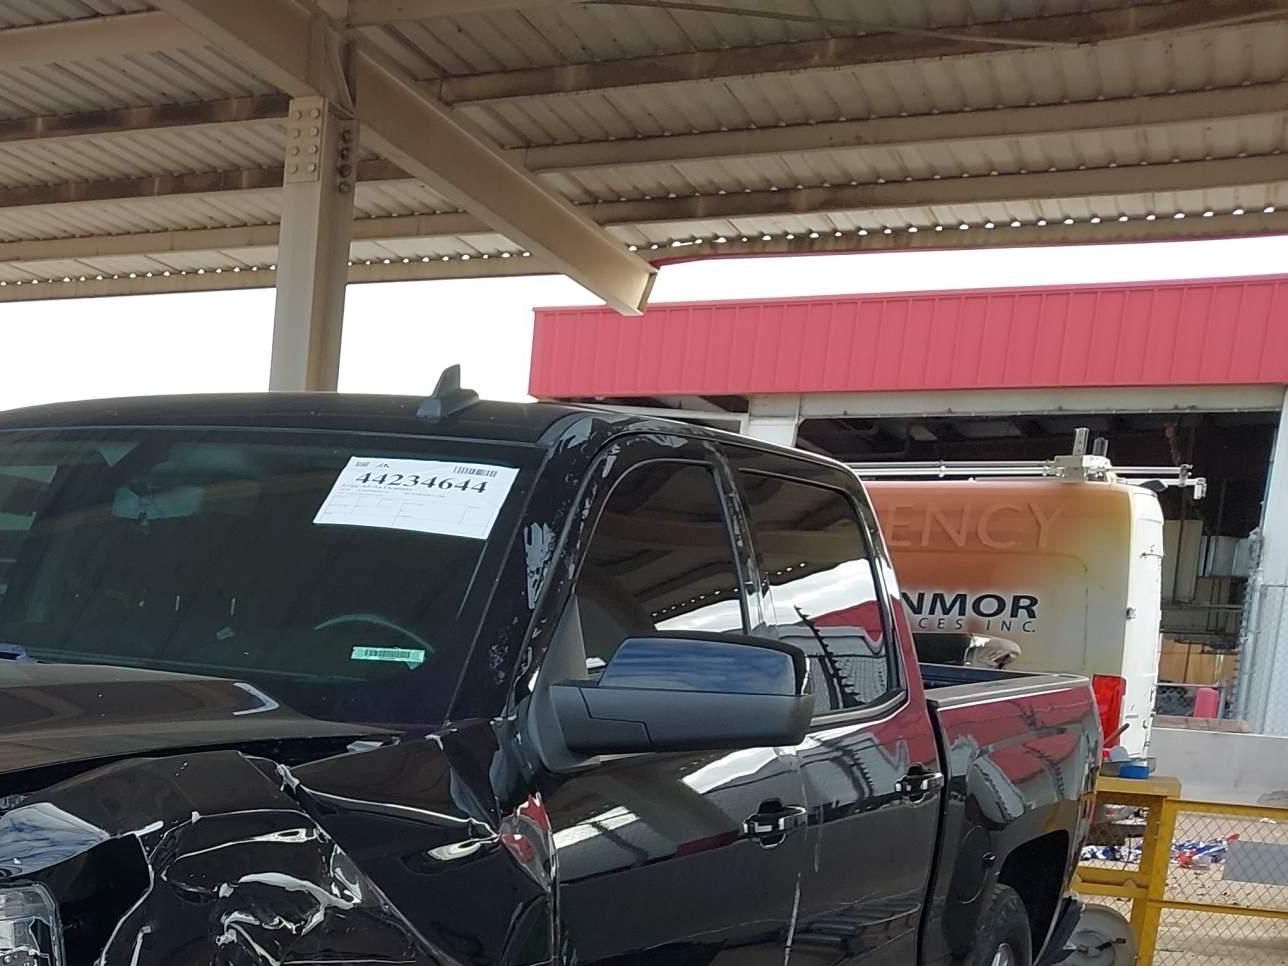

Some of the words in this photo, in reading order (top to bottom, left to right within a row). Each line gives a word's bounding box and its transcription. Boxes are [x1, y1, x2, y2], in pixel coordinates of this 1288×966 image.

[355, 472, 489, 494] 44234644
[886, 503, 1066, 549] ENCY
[986, 618, 1035, 633] INC.
